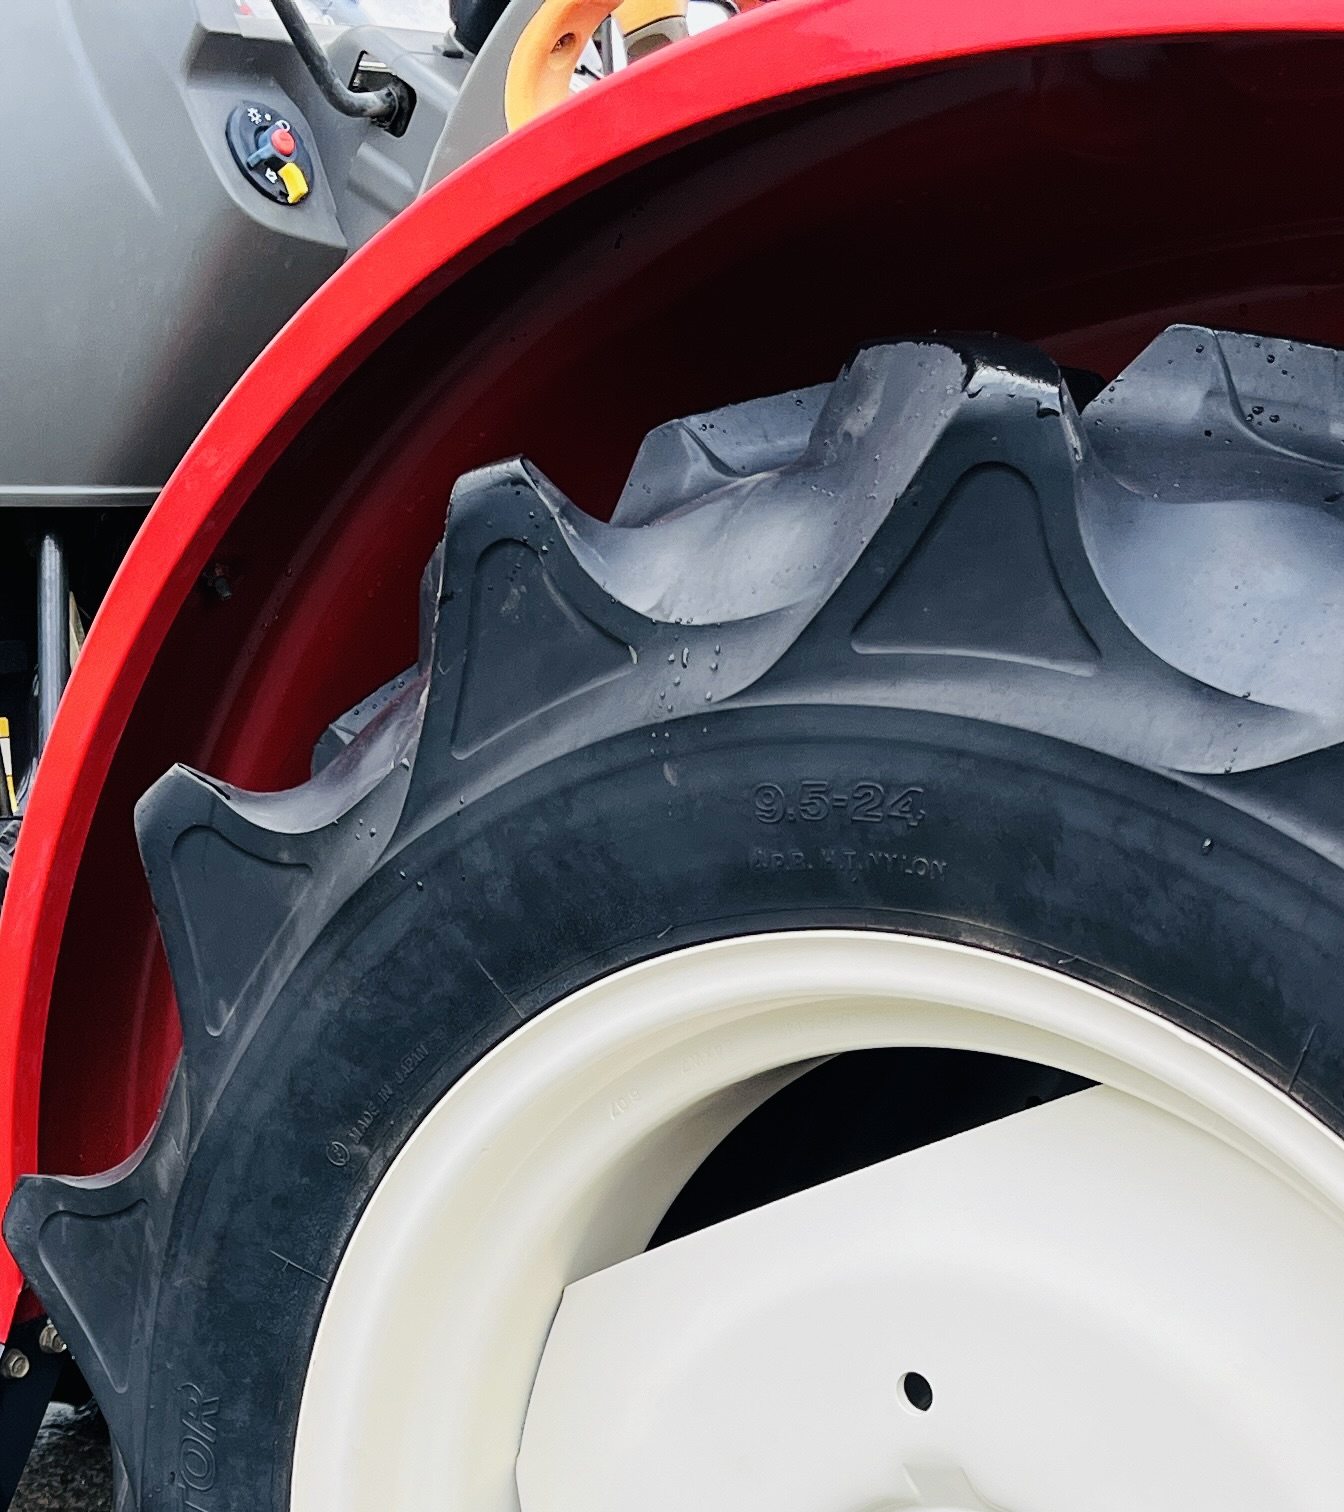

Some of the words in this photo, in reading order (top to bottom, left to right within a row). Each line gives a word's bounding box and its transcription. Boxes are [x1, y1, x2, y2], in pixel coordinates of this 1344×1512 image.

[754, 779, 926, 827] 9.5-24
[377, 1083, 394, 1103] IN
[394, 1042, 431, 1085] JAPAN
